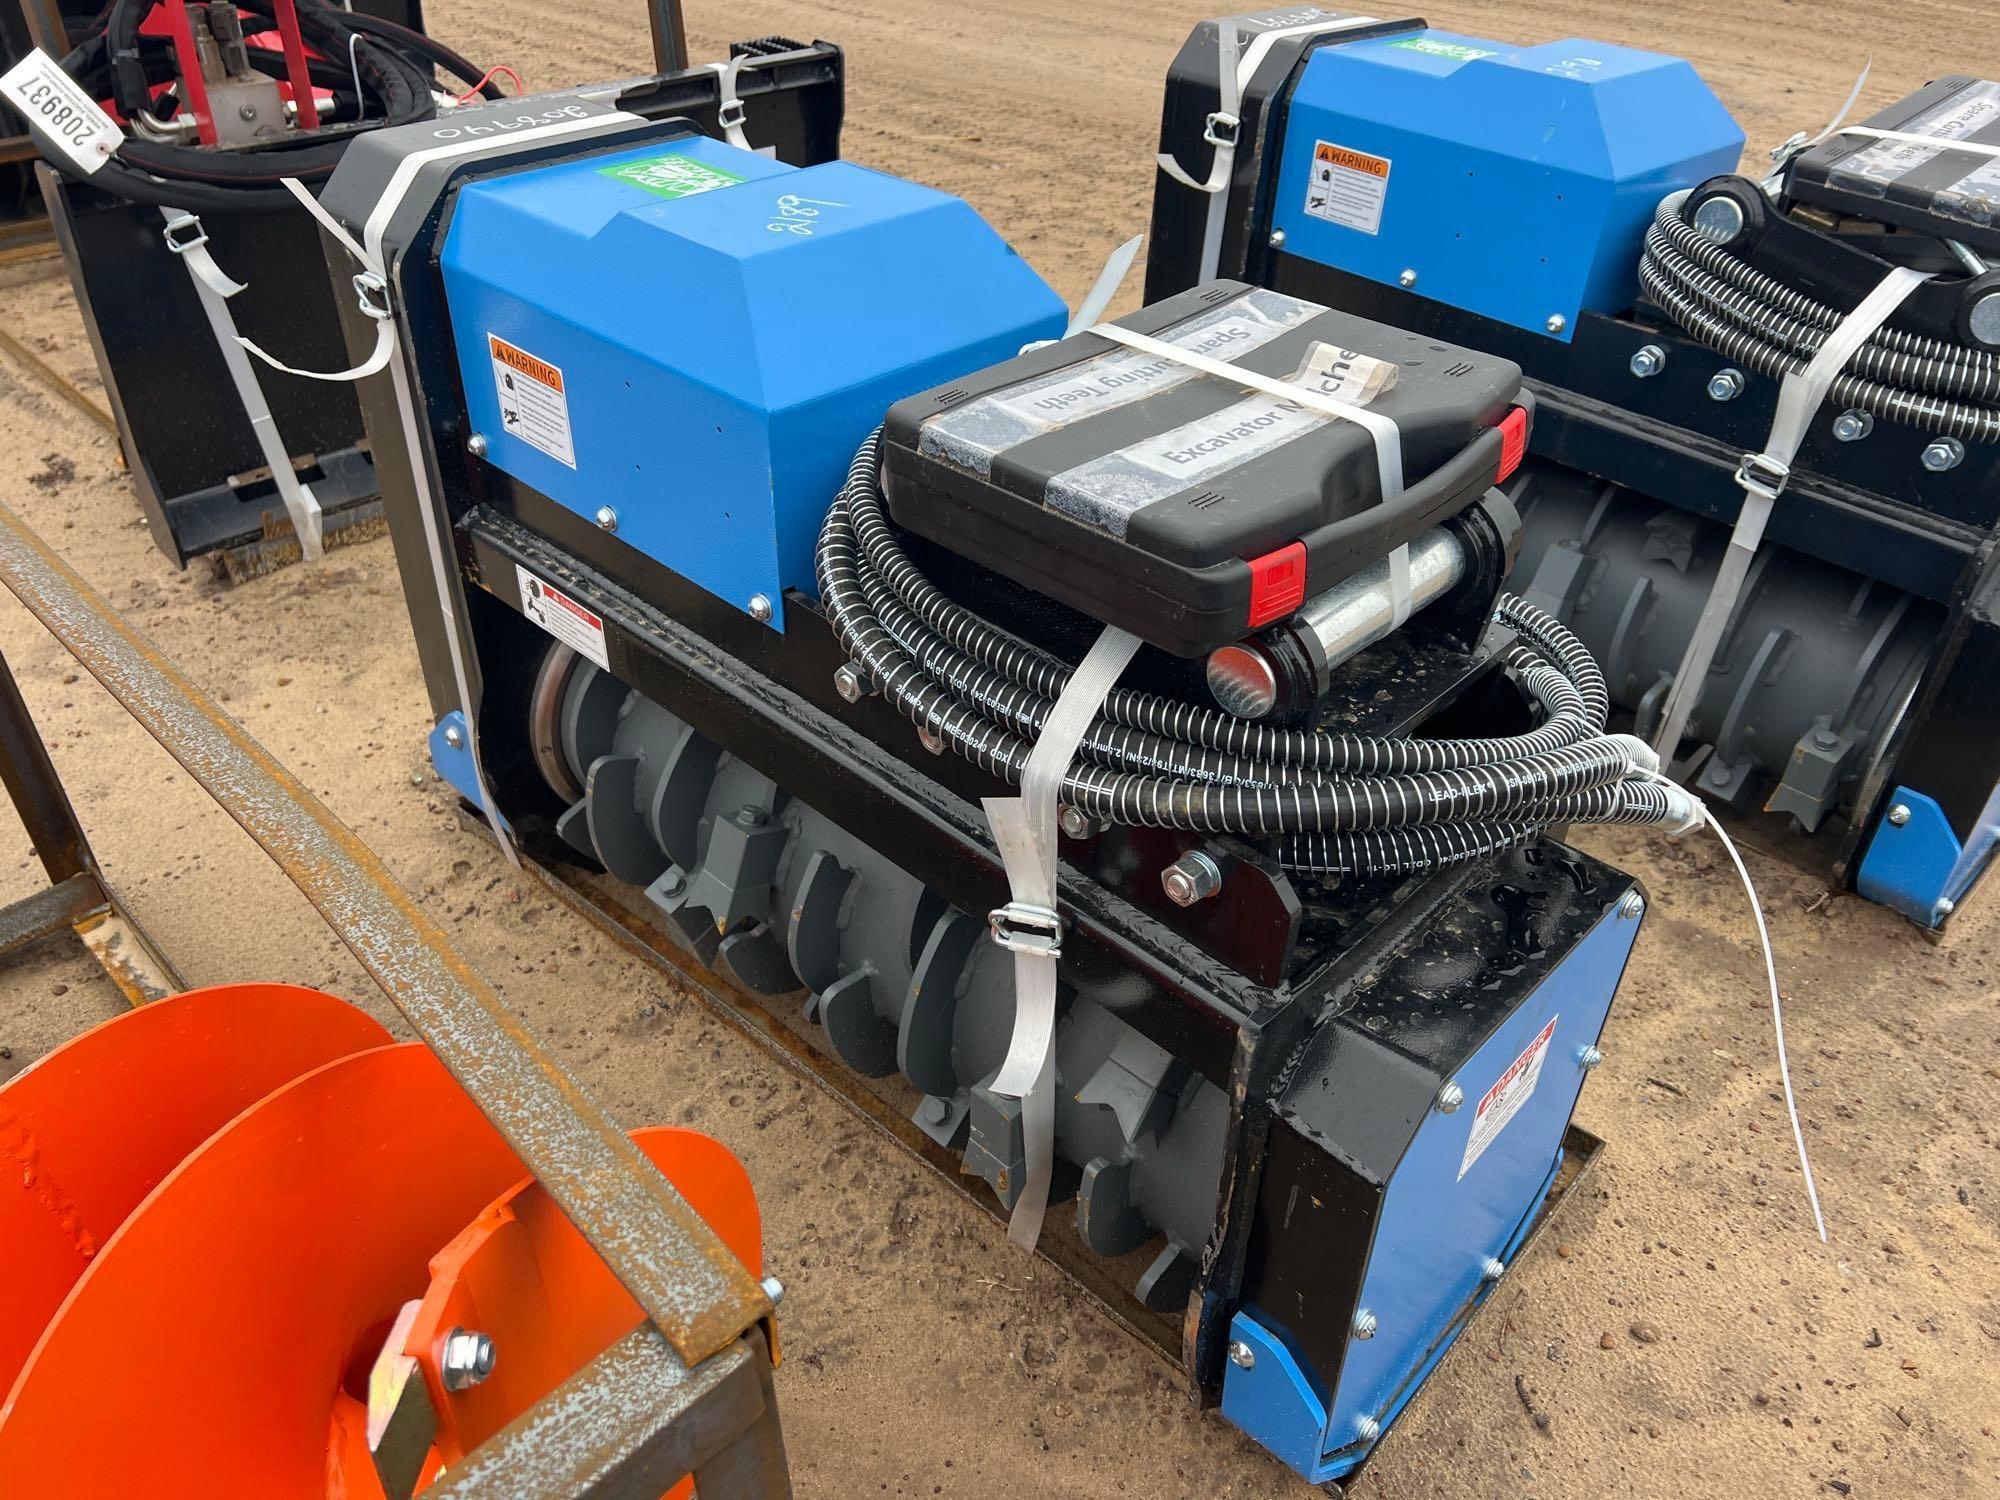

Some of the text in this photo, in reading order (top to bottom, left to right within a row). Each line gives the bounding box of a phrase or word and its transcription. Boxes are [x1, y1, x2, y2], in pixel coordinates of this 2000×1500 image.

[16, 76, 96, 146] 208937
[433, 104, 587, 139] 208940
[1332, 150, 1381, 174] WARNING
[507, 351, 556, 386] WARNING
[1034, 385, 1111, 410] Teeth
[1160, 410, 1284, 466] Excavator
[560, 598, 589, 620] DANGER
[895, 684, 924, 712] 2.0MPa
[1497, 1030, 1547, 1092] DANGER
